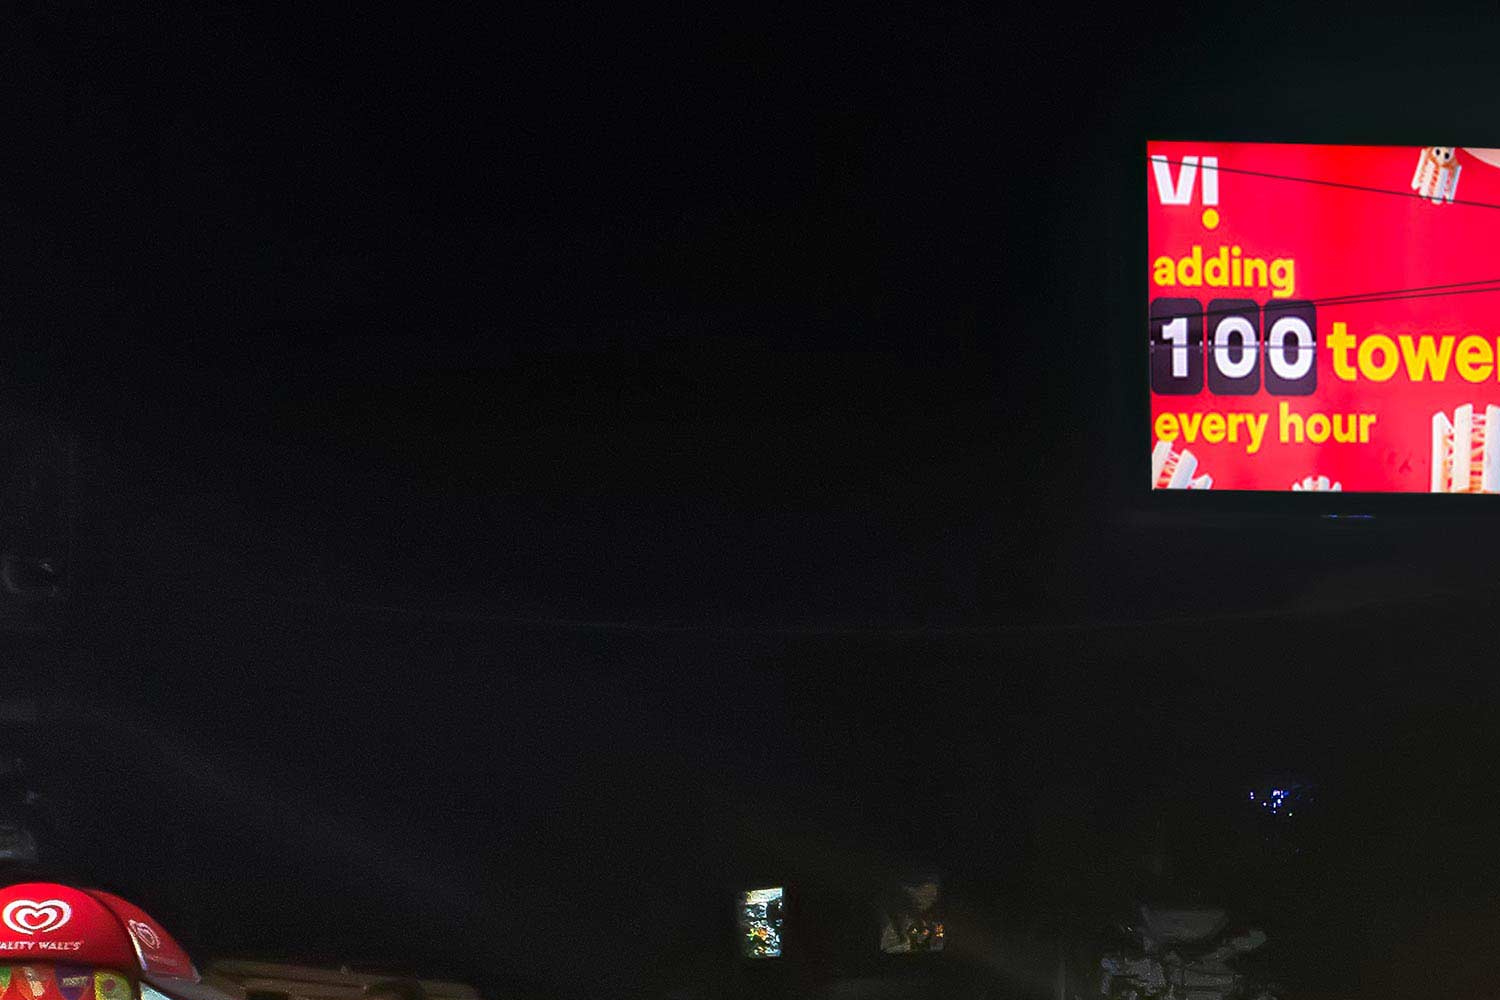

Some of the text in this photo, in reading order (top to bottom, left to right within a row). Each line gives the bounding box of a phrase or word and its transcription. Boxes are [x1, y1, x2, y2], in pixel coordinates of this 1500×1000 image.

[1153, 247, 1295, 296] adding
[1159, 316, 1314, 379] 100
[1155, 402, 1376, 451] every hour
[0, 941, 35, 950] ALITY
